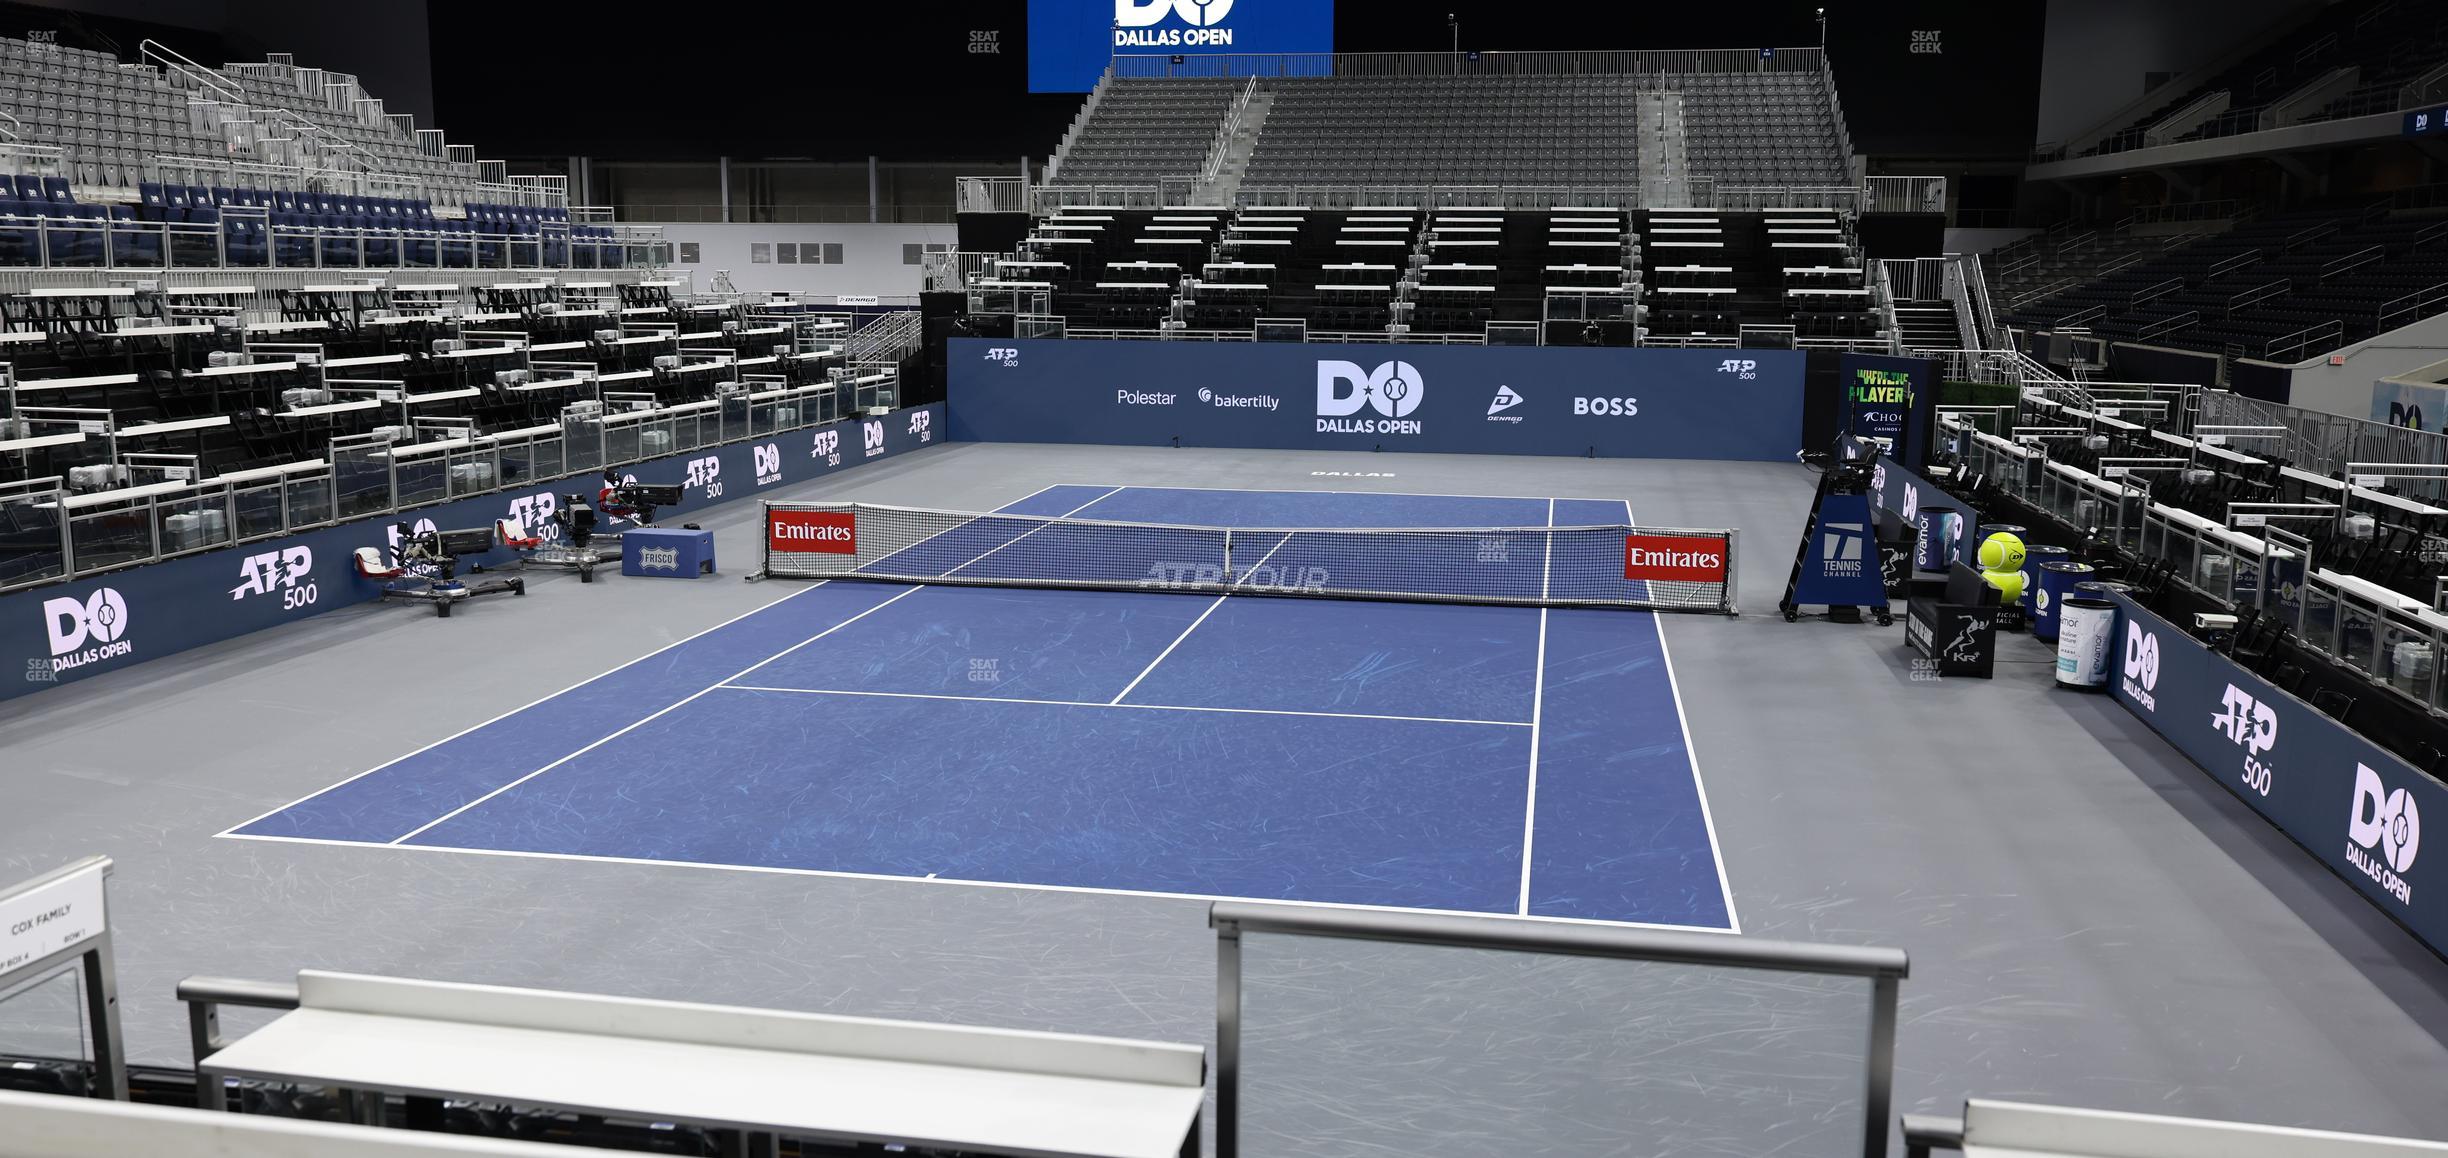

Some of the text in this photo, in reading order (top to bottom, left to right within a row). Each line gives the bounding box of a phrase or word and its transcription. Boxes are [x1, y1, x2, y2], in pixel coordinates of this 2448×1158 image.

[1115, 29, 1232, 46] DALLAS OPEN
[983, 348, 1018, 360] ATP
[1716, 359, 1756, 373] ATP
[1739, 372, 1755, 380] 500
[1117, 390, 1176, 405] Polestar
[1316, 360, 1424, 418] DO
[1215, 395, 1279, 411] bakertilly
[1574, 397, 1638, 416] BOSS
[907, 410, 930, 434] ATP
[1316, 418, 1421, 434] DALLAS OPEN
[810, 429, 838, 458] ATP
[921, 430, 931, 443] 500
[753, 443, 780, 477] DO
[828, 452, 840, 467] 500
[865, 447, 885, 458] DALLAS OPEN
[683, 455, 720, 490] ATP
[757, 472, 782, 486] DALLAS OPEN
[706, 481, 723, 499] 500
[537, 523, 559, 542] 500
[774, 521, 851, 541] Emirates
[1919, 515, 1929, 565] evamor
[644, 553, 673, 566] FRISCO
[1631, 547, 1720, 568] Emirates
[1823, 560, 1862, 571] TENNIS
[228, 545, 312, 601] ATP
[283, 583, 318, 610] 500
[43, 587, 128, 656] DO
[53, 639, 132, 673] DALLAS OPEN
[2093, 633, 2103, 670] evamor
[2124, 619, 2160, 692] DO
[2122, 677, 2156, 713] DALLAS OPEN
[2211, 683, 2278, 756] ATP
[2241, 754, 2272, 797] 500
[2348, 762, 2420, 873] DO
[2346, 841, 2412, 906] DALLAS OPEN
[11, 903, 72, 936] COX FAMILY
[7, 955, 22, 967] BOX
